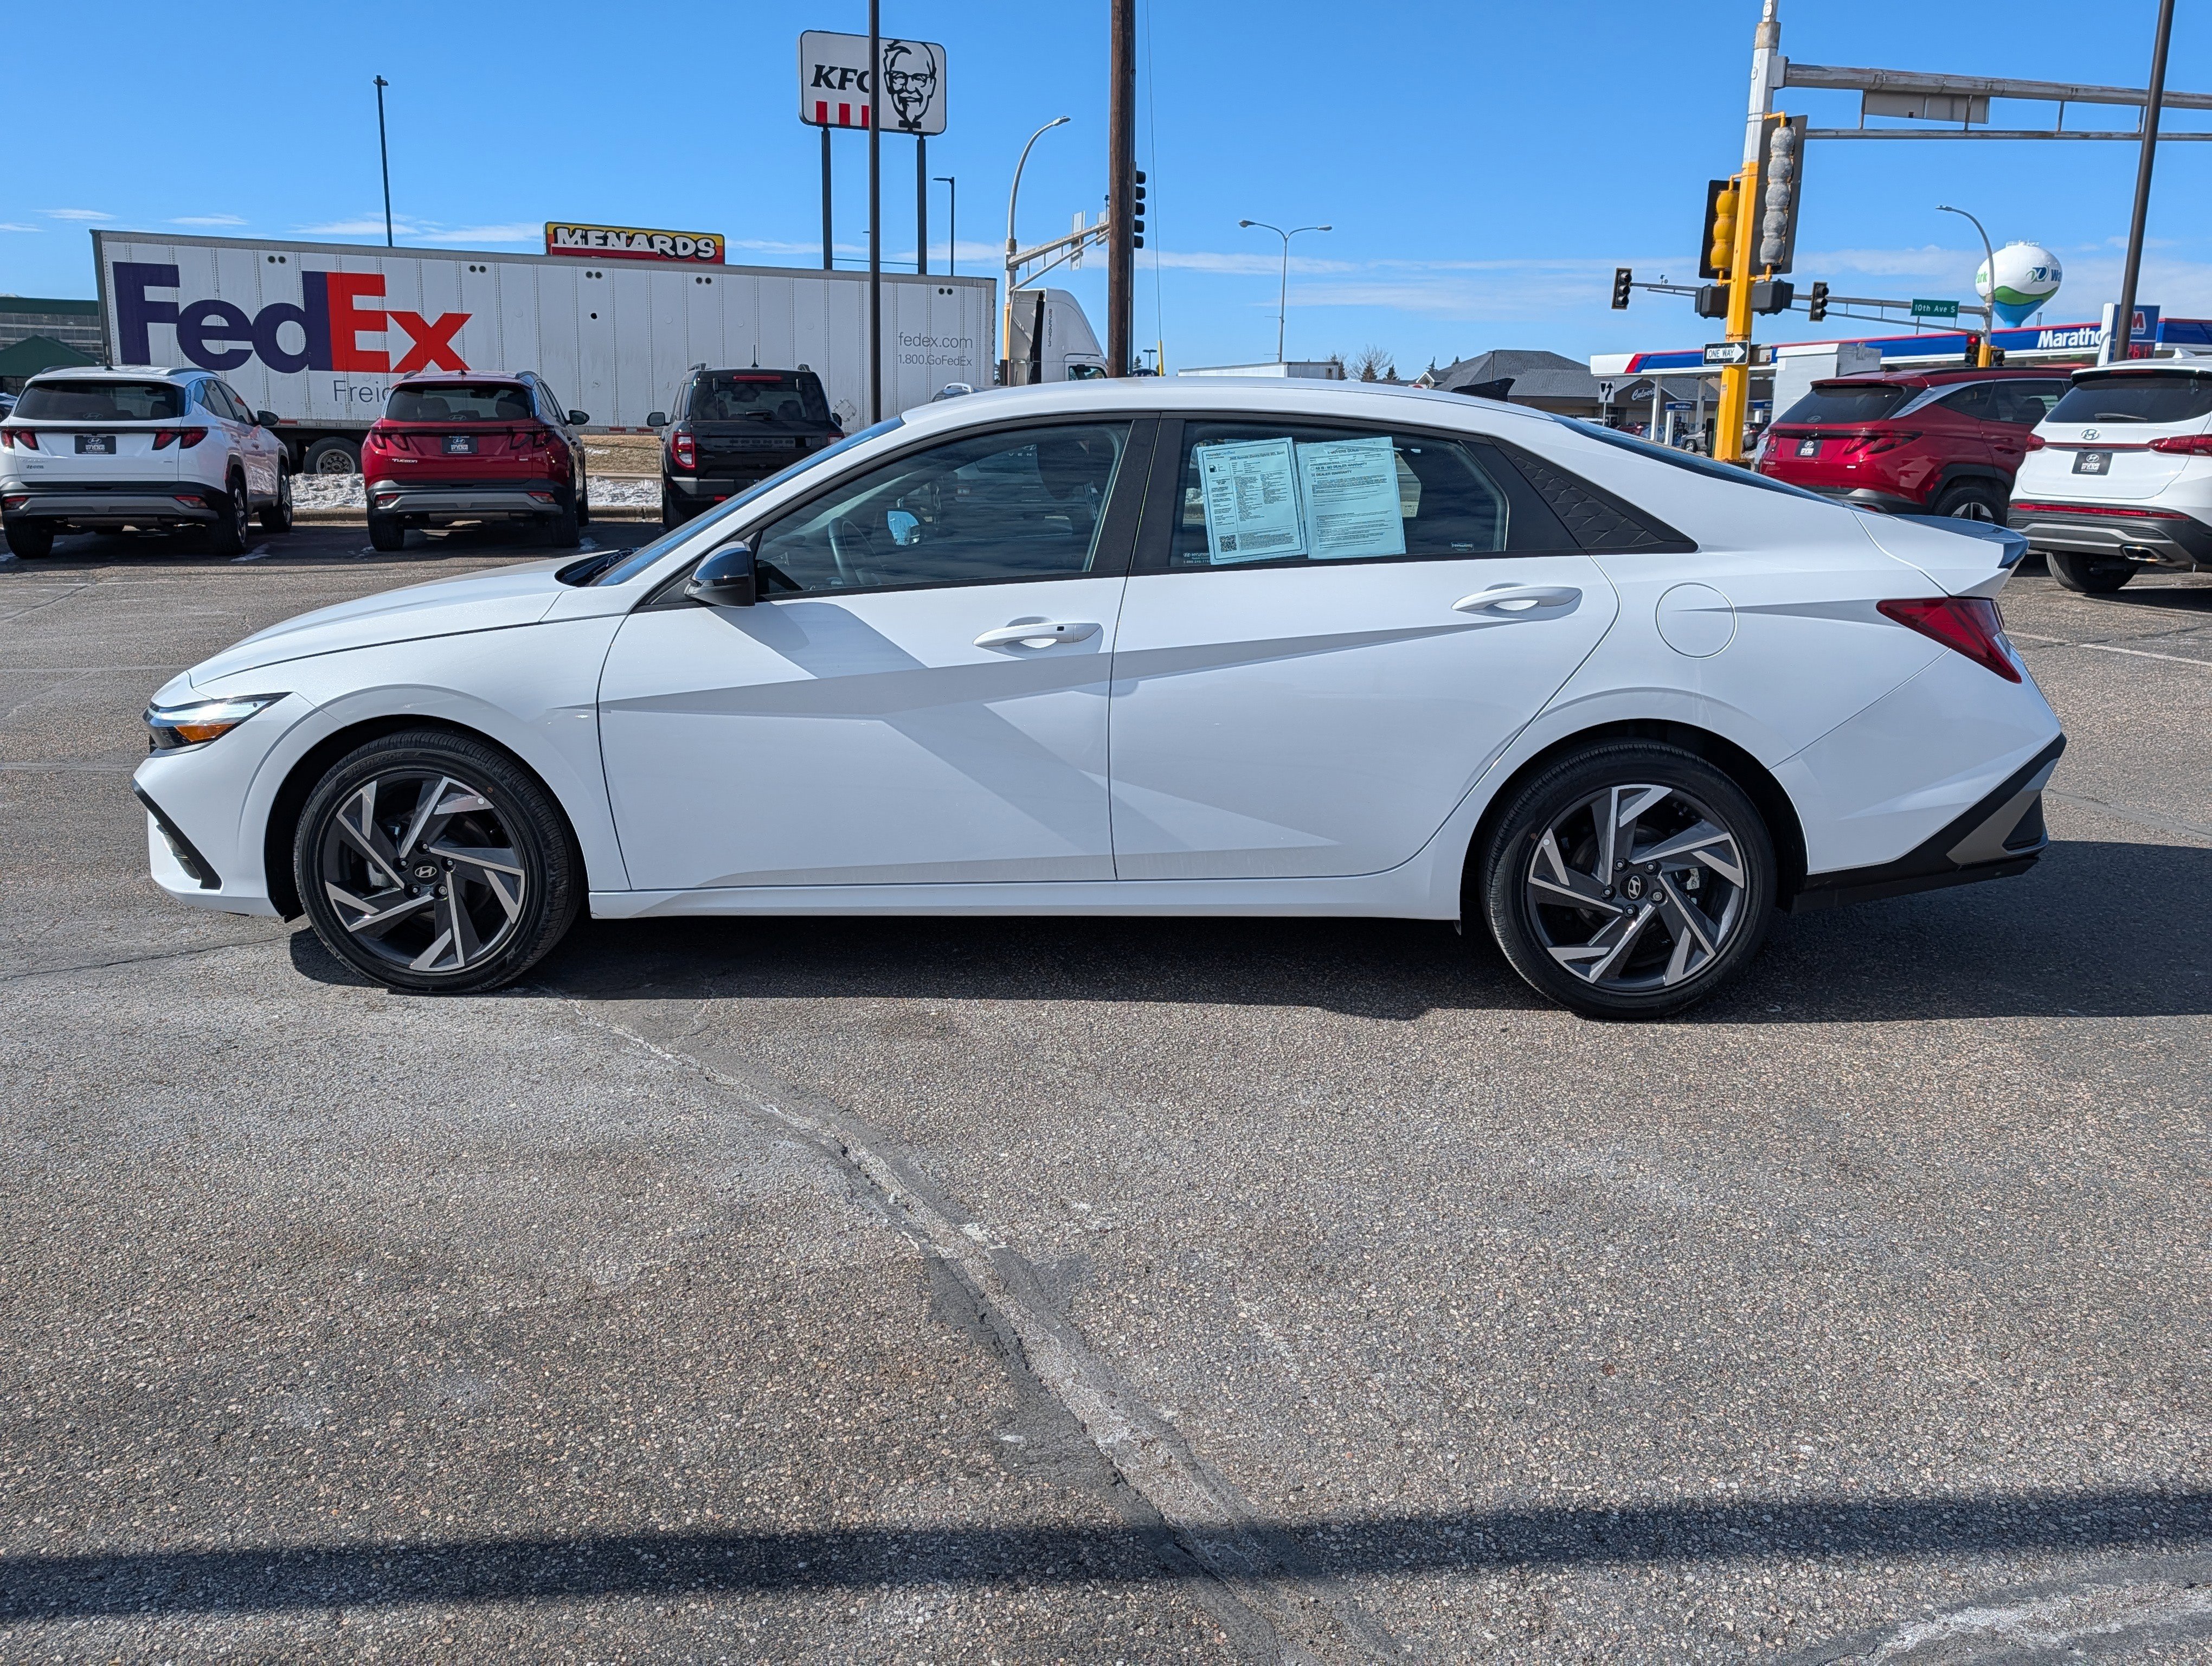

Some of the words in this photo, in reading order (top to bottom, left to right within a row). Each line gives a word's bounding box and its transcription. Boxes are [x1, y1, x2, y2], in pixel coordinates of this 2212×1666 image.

[556, 228, 716, 258] MENARDS
[1976, 271, 1988, 284] ark
[1914, 304, 1930, 312] 10th
[1933, 305, 1947, 313] Ave
[1950, 305, 1956, 313] S
[112, 261, 473, 374] FedEx
[898, 332, 973, 349] fedex.com
[2036, 328, 2101, 348] Maratho
[898, 354, 973, 367] 1.800.GoFedEx
[1708, 349, 1720, 358] ONE
[1722, 349, 1734, 357] WAY
[333, 380, 390, 402] Frei
